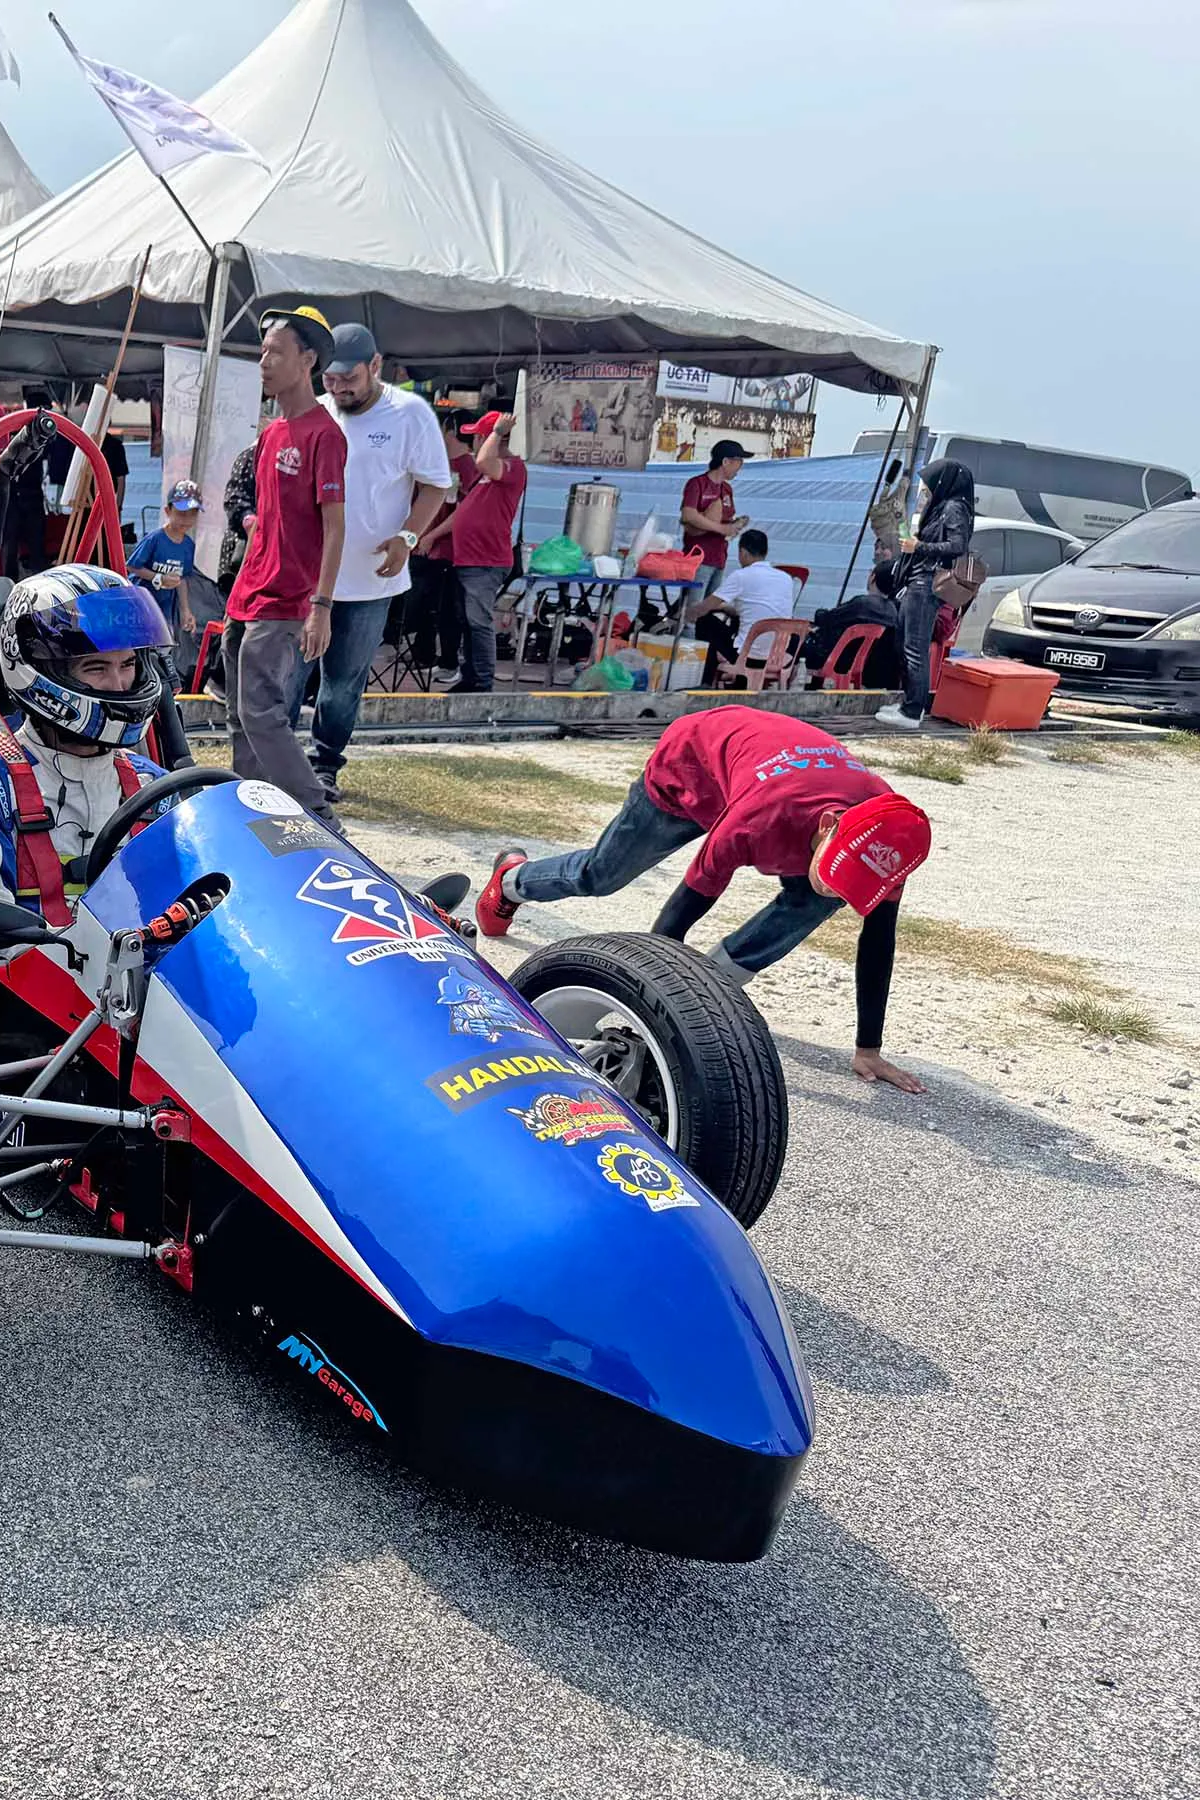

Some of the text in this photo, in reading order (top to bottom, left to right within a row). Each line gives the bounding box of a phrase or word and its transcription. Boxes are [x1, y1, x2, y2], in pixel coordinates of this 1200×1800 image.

[594, 364, 630, 377] RACING
[667, 366, 710, 384] UC TATI
[351, 941, 424, 963] UNIVERSITY
[415, 951, 442, 960] TATI
[440, 1055, 575, 1101] HANDAL
[317, 1367, 374, 1423] Garage
